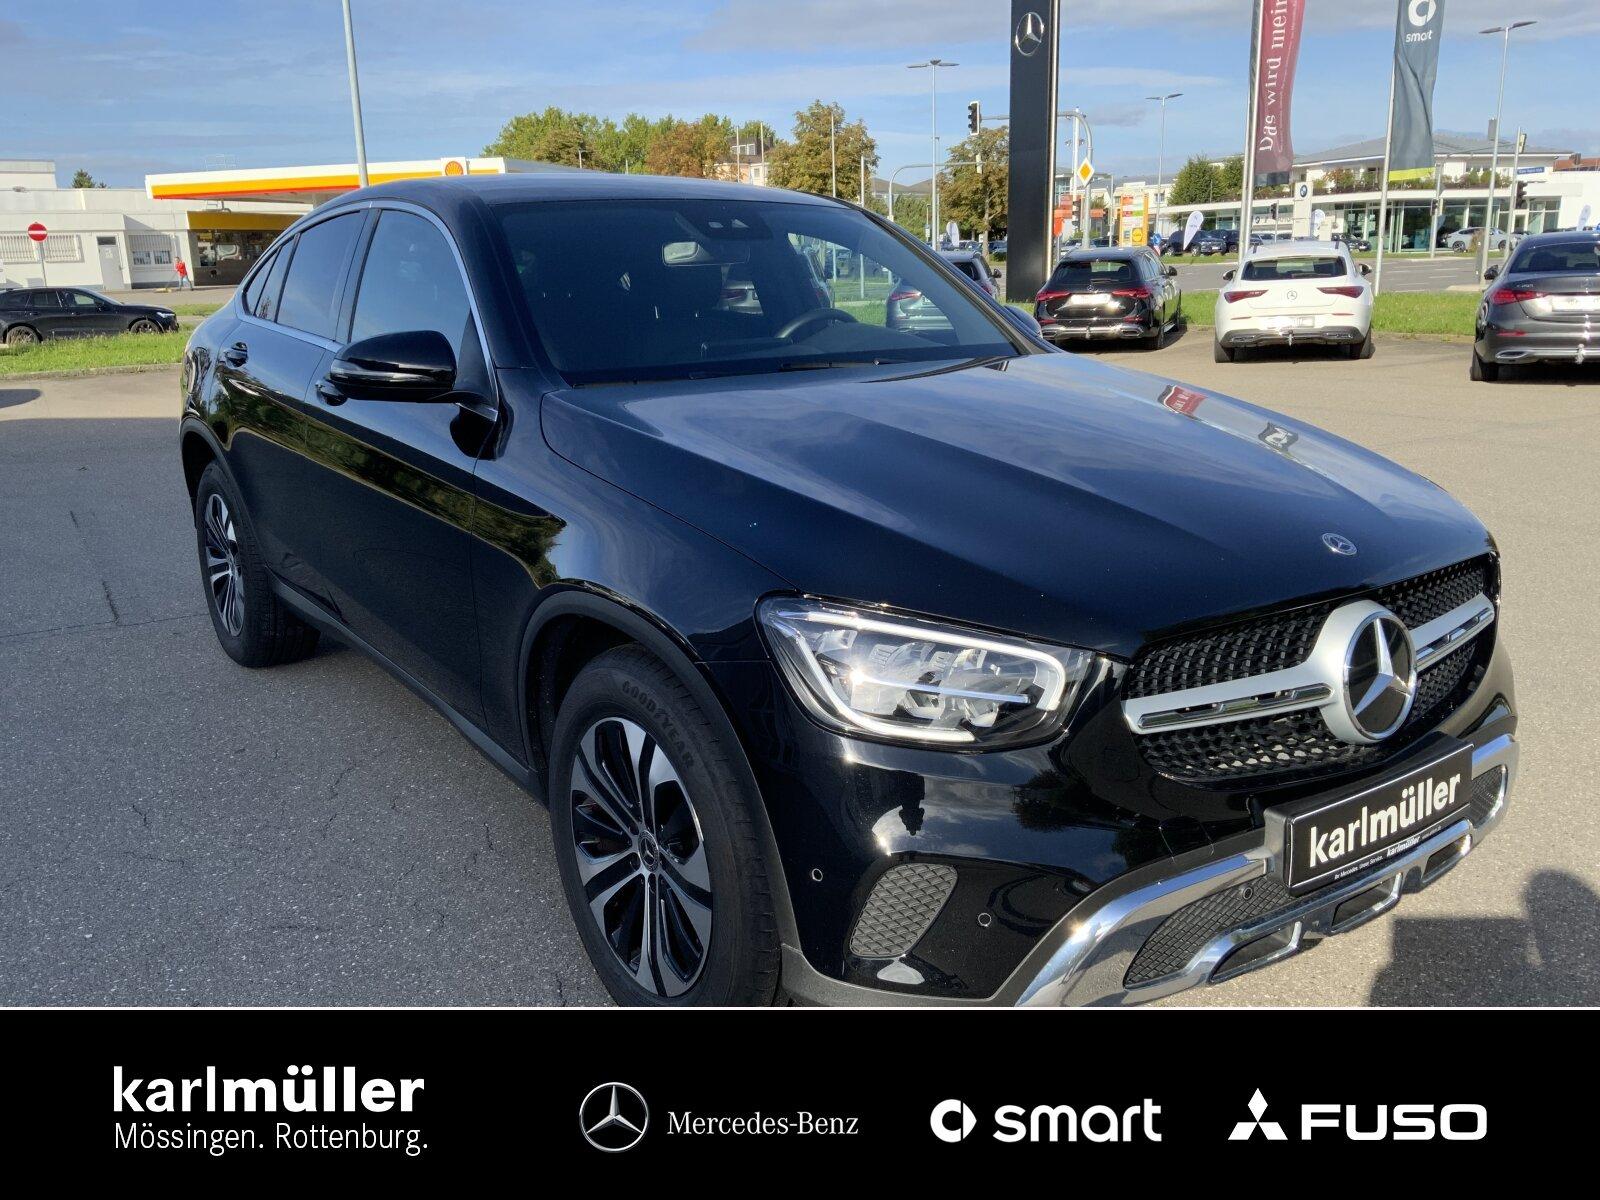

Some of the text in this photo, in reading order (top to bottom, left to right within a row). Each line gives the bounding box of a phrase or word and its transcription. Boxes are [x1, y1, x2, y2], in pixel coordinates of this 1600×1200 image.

[1405, 29, 1433, 43] smart
[1265, 56, 1282, 106] wird
[1259, 115, 1278, 151] Das
[622, 680, 694, 768] GOODYEAR
[1309, 773, 1461, 868] karlmüller
[1387, 836, 1421, 857] karlmüller
